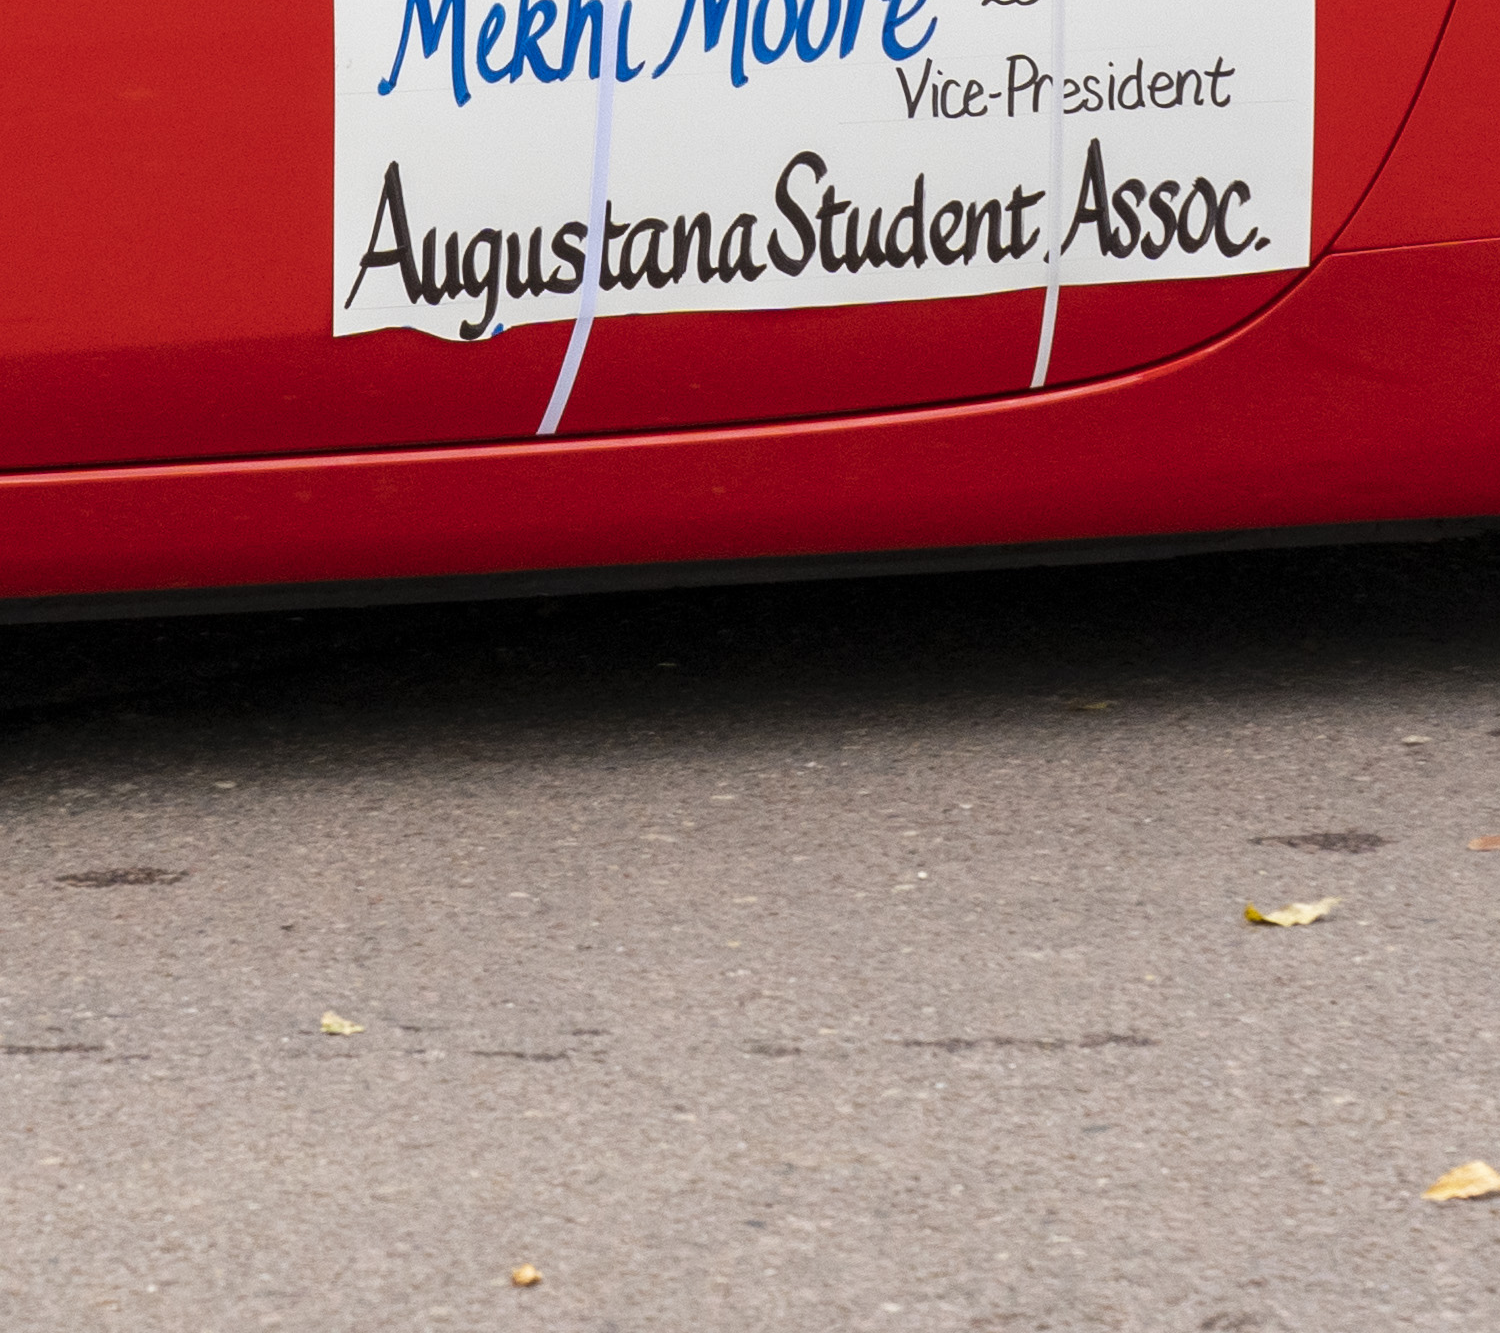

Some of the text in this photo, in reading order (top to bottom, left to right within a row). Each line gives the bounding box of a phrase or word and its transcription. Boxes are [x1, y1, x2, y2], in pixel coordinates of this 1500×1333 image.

[894, 55, 1236, 120] Vice-President
[343, 136, 1272, 342] Augustana Student Assoc.
